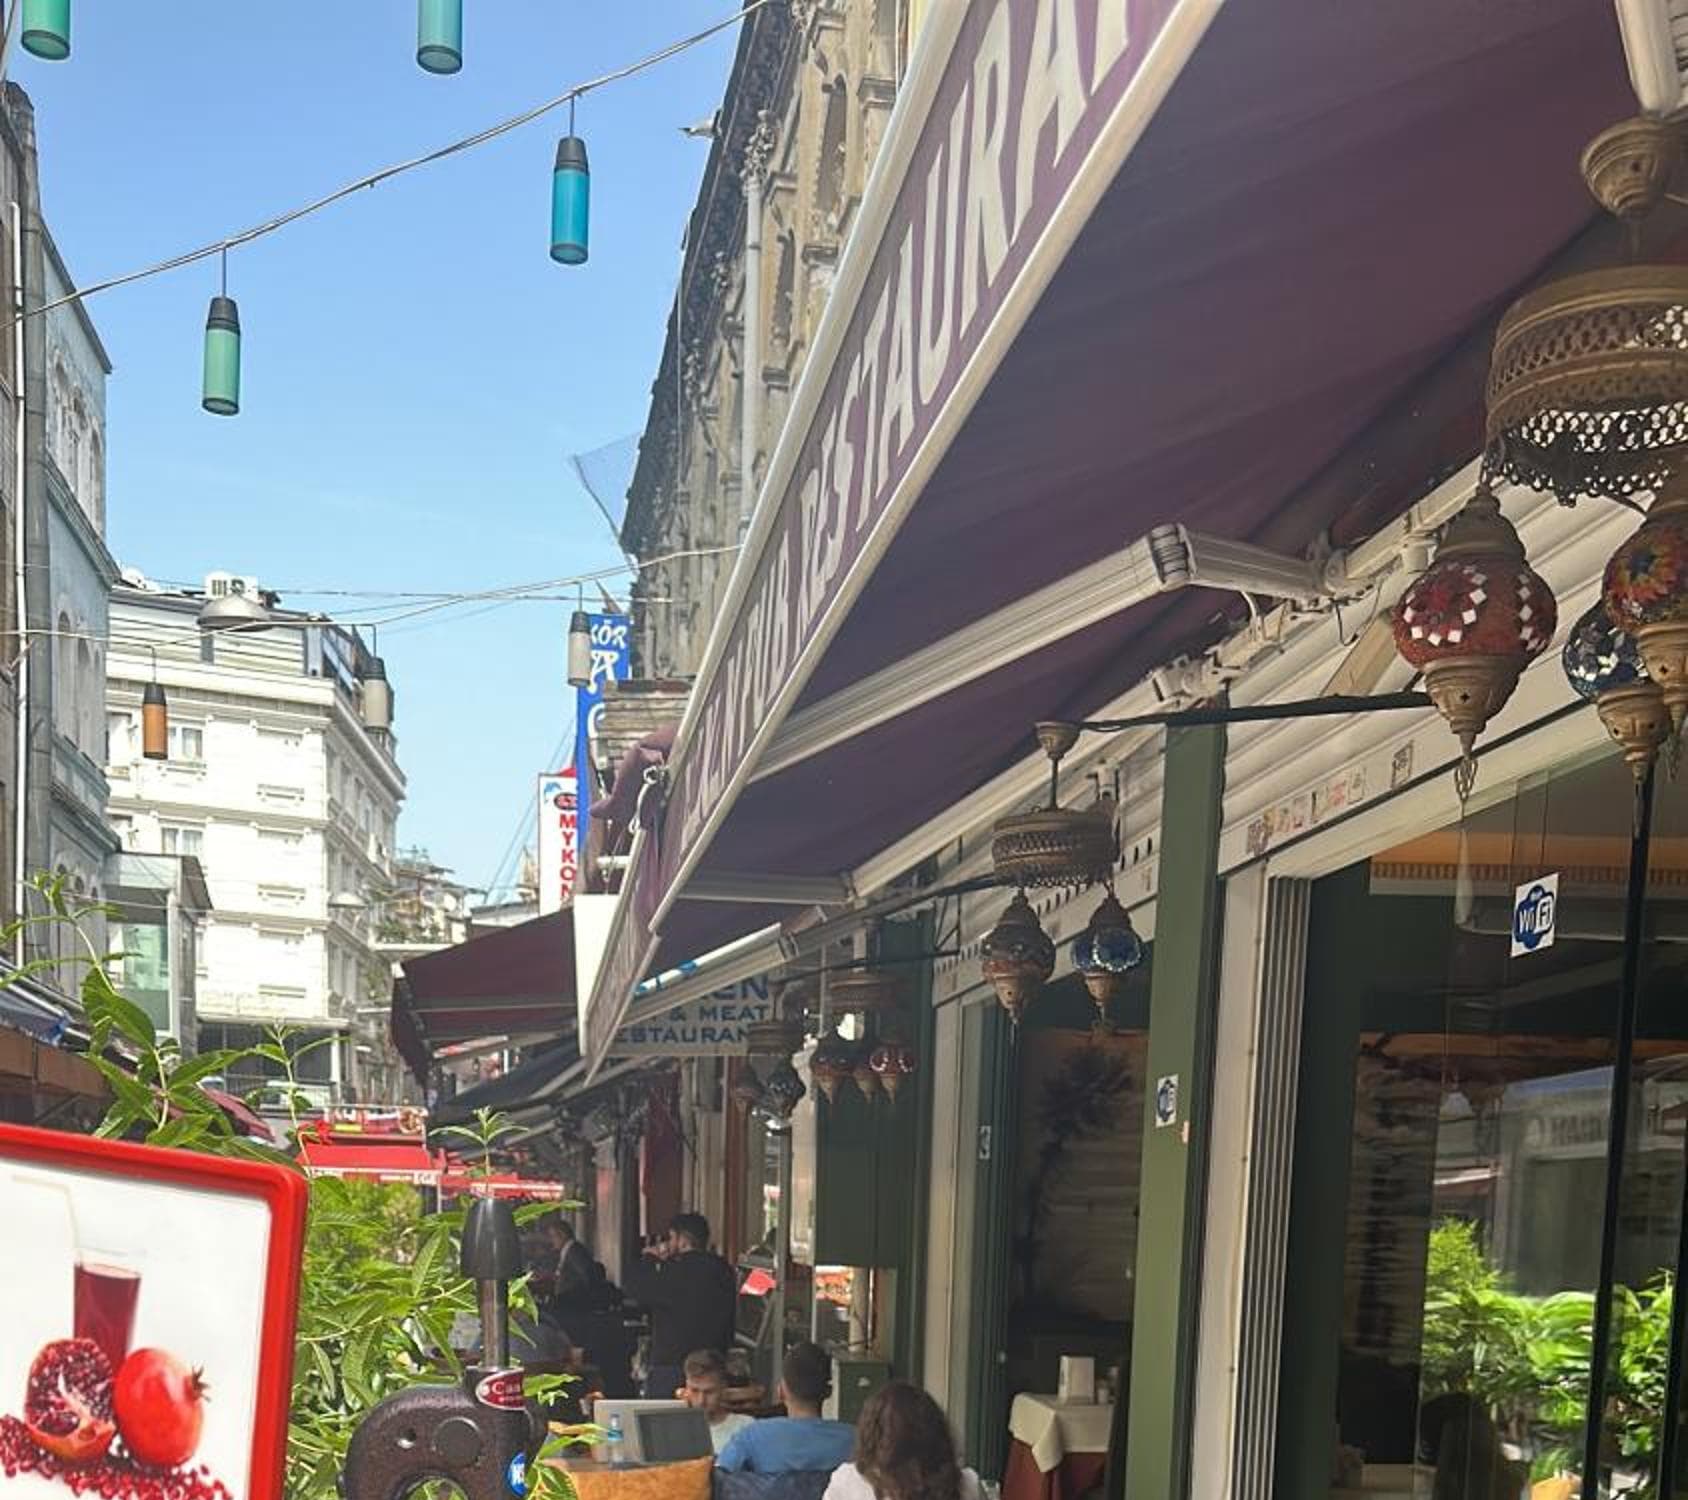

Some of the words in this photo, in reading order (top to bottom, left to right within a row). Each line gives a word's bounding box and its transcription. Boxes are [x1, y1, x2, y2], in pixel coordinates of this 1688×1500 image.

[736, 526, 788, 758] PUB
[796, 0, 1129, 664] RESTAURA
[670, 1006, 686, 1022] &
[700, 1005, 768, 1022] MEAT
